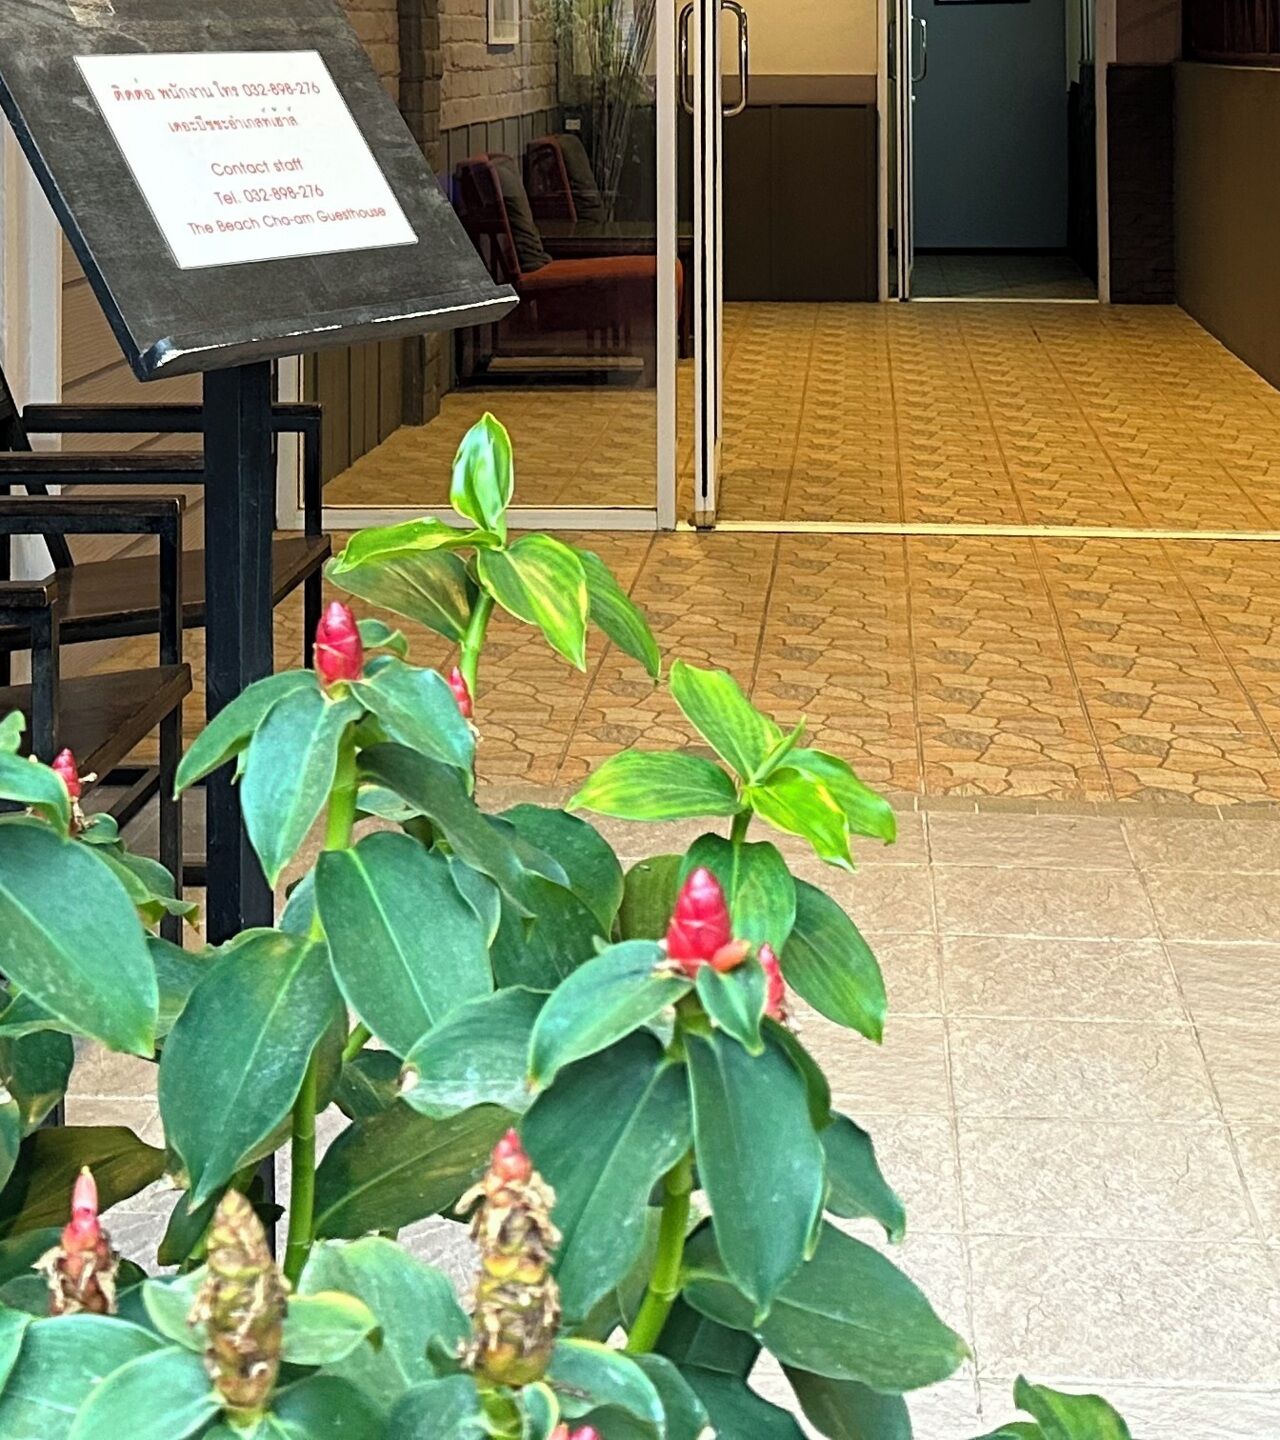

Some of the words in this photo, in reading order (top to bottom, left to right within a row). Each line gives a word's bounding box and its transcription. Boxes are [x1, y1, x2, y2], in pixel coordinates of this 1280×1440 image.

[111, 78, 155, 101] ติดต่อ
[158, 83, 214, 99] พนักงาน
[242, 81, 320, 96] 032-898-276
[211, 160, 270, 176] Contact
[273, 158, 303, 172] staff
[214, 190, 241, 205] Tel.
[243, 184, 324, 202] 032-898-276
[187, 222, 214, 235] The
[216, 217, 261, 232] Beach
[262, 212, 315, 228] Cha-am
[317, 207, 386, 222] Guesthouse
